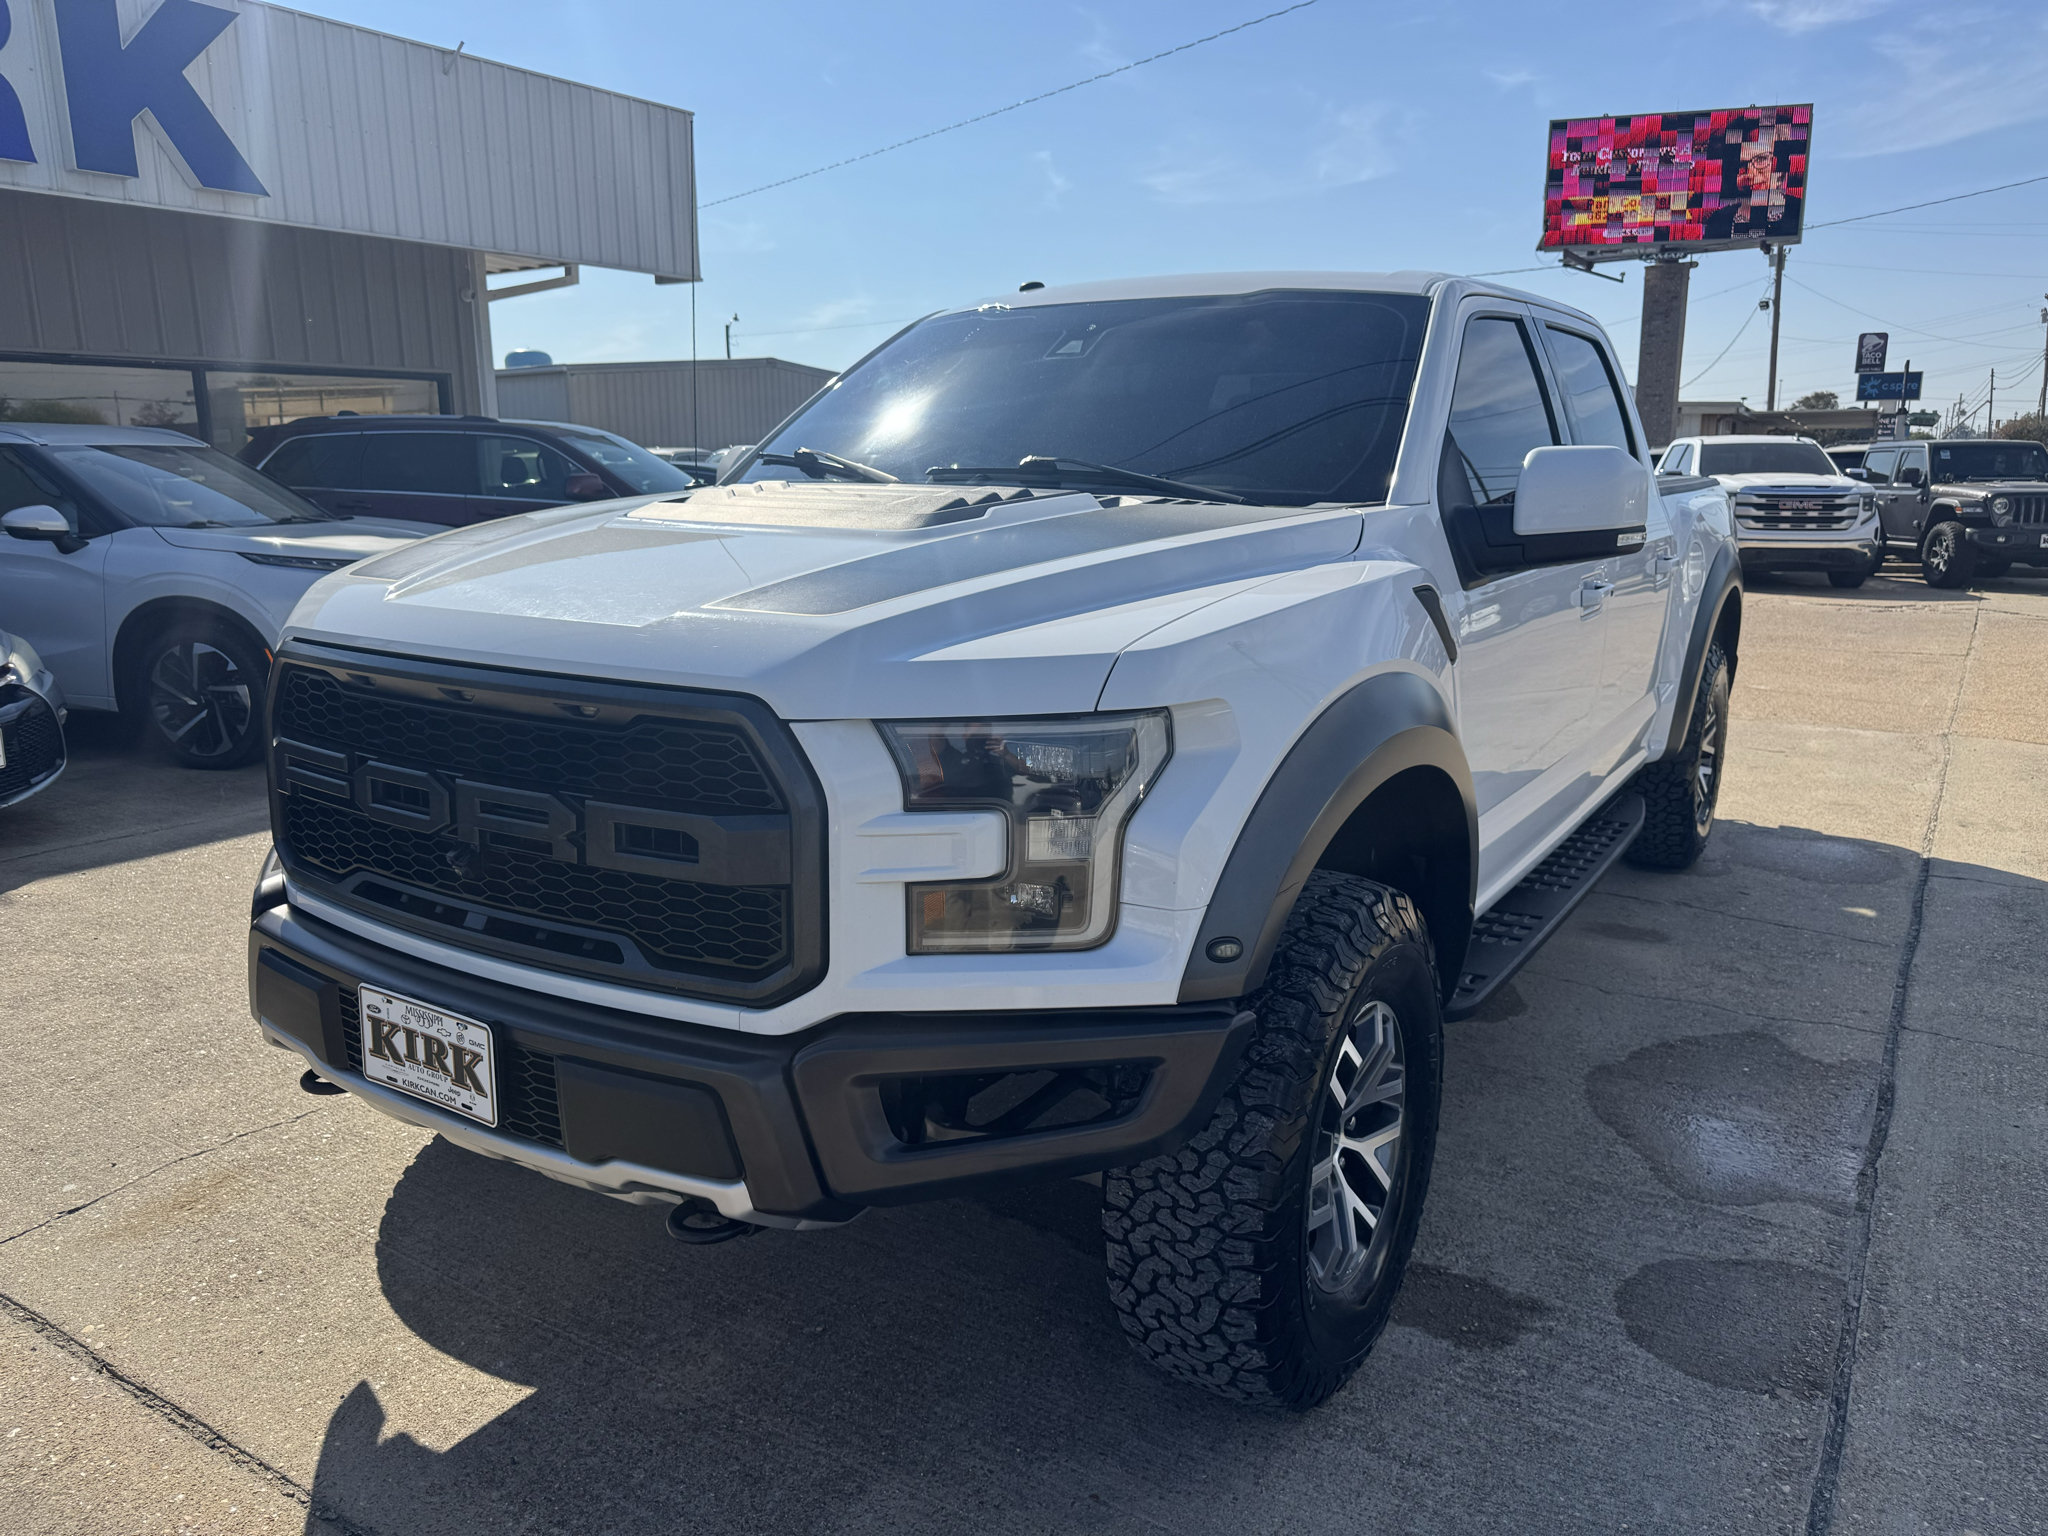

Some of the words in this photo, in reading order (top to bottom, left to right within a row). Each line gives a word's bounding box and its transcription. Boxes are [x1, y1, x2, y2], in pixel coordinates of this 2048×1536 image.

[1862, 351, 1882, 359] TACO
[1778, 499, 1823, 510] GMC
[274, 738, 726, 886] FORD
[405, 1005, 444, 1029] MISSISSIPPI
[468, 1039, 486, 1050] GMC
[366, 1013, 488, 1099] KIRK
[407, 1063, 425, 1075] AUTO
[426, 1070, 449, 1083] GROUP
[401, 1078, 457, 1105] KIRKCAN.COM
